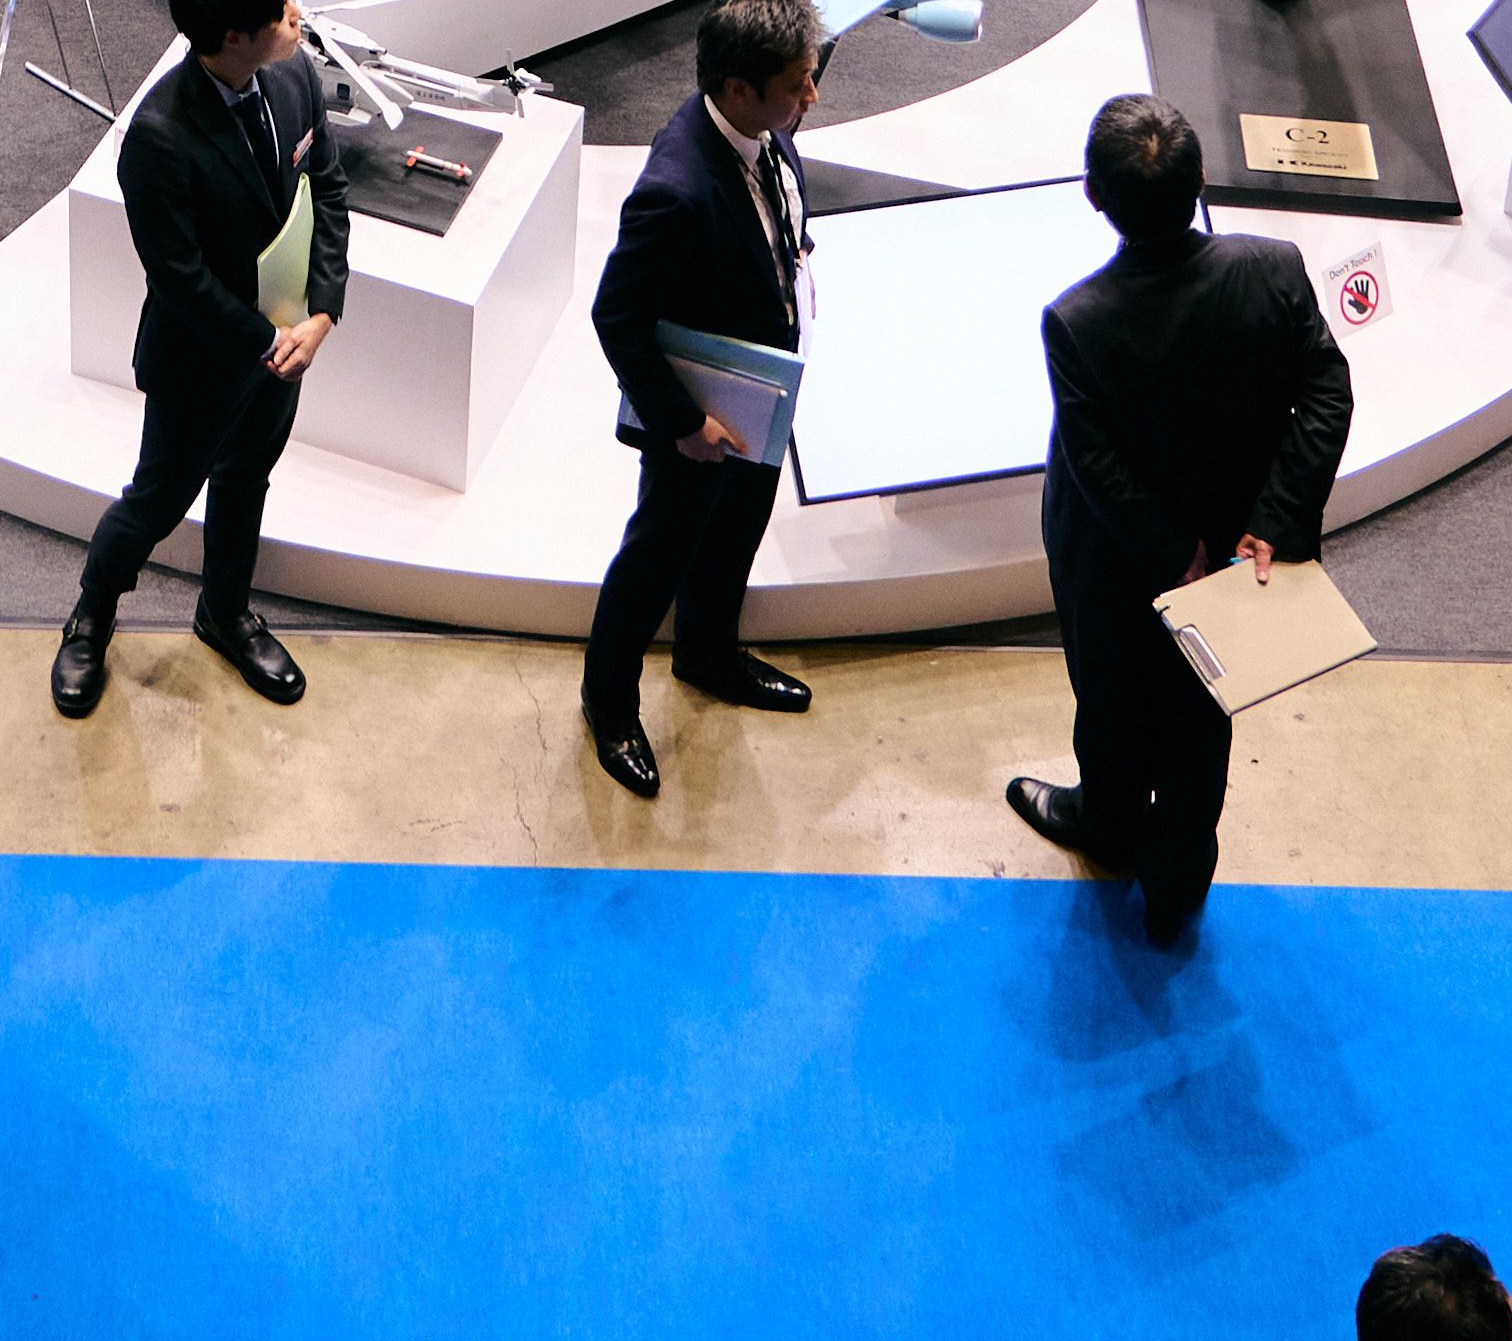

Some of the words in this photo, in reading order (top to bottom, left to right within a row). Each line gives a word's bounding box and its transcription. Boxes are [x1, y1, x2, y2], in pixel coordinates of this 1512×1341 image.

[1285, 127, 1330, 145] C-2
[1300, 161, 1348, 170] Kawasaki
[1328, 263, 1351, 281] Don't
